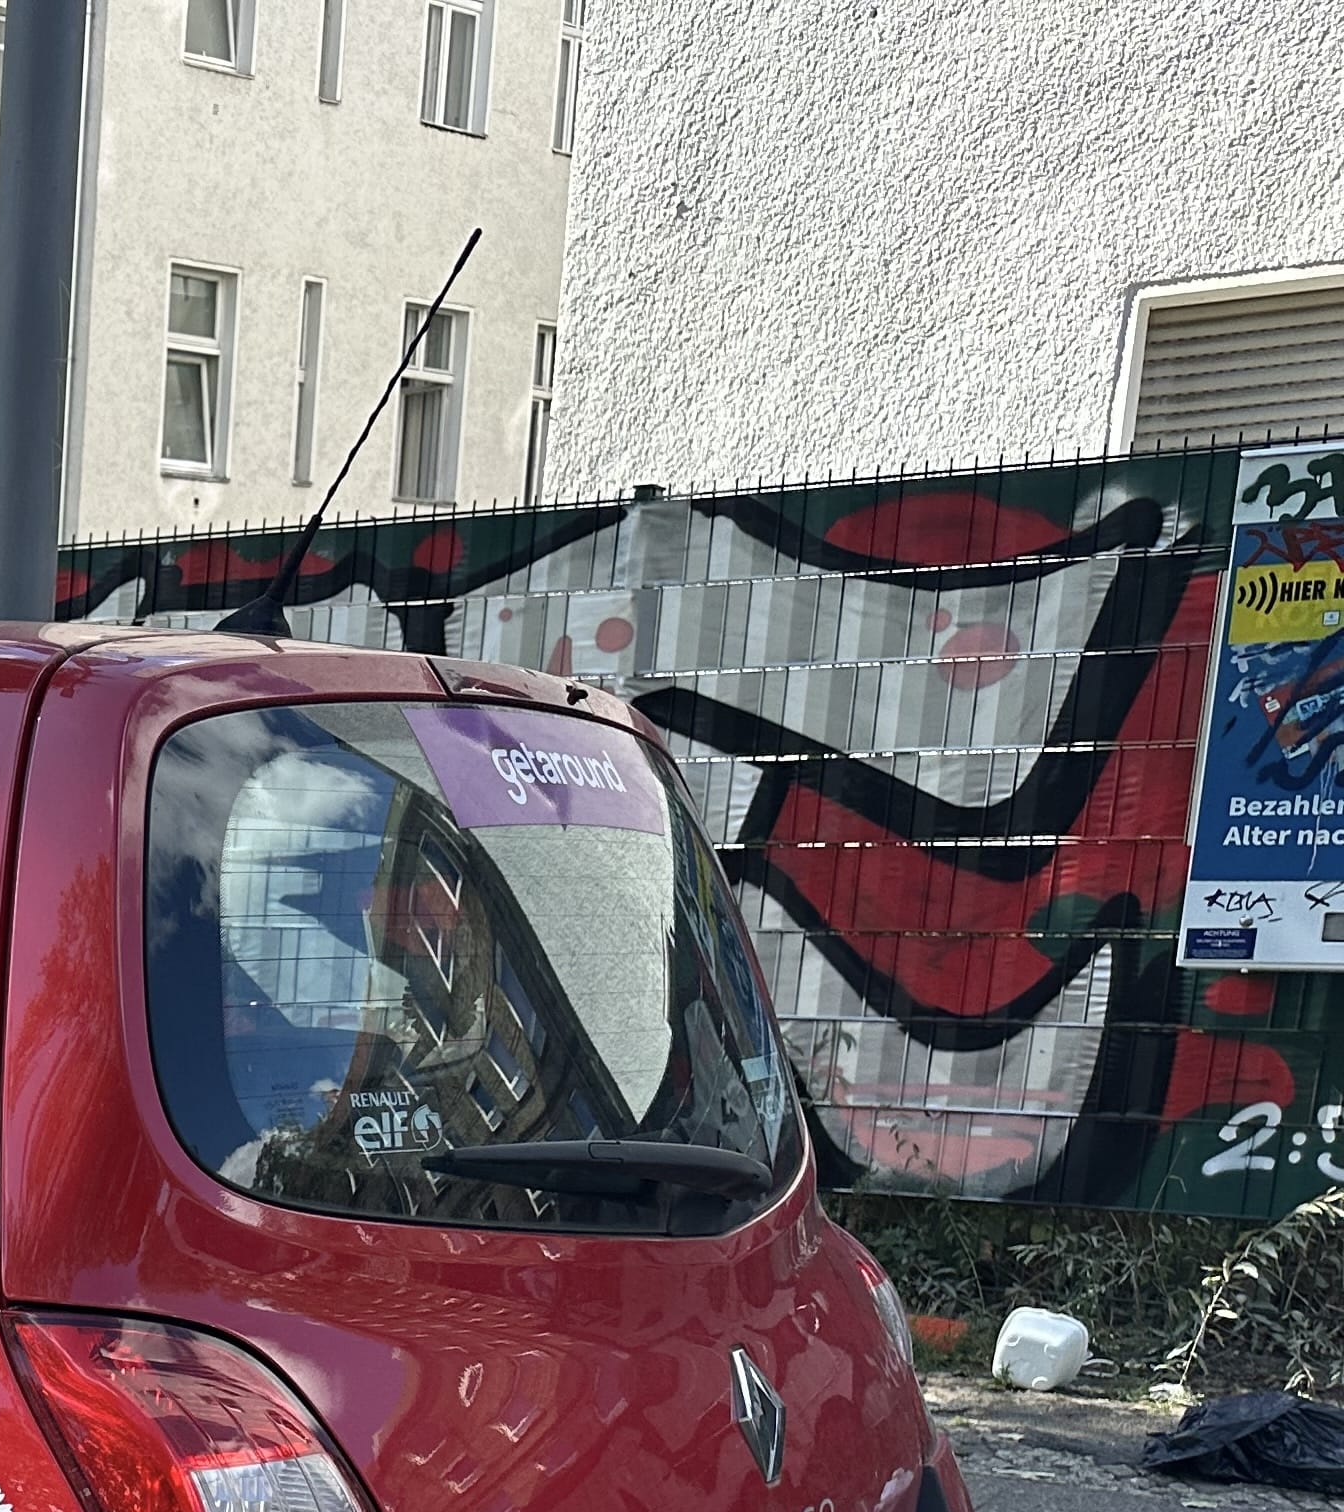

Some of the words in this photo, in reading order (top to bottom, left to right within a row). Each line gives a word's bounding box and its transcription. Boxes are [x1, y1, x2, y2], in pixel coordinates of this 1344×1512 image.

[1279, 580, 1326, 602] HIER
[491, 742, 628, 805] getaround
[1222, 825, 1292, 846] Alter
[350, 1091, 410, 1108] RENAULT
[354, 1111, 409, 1150] elf
